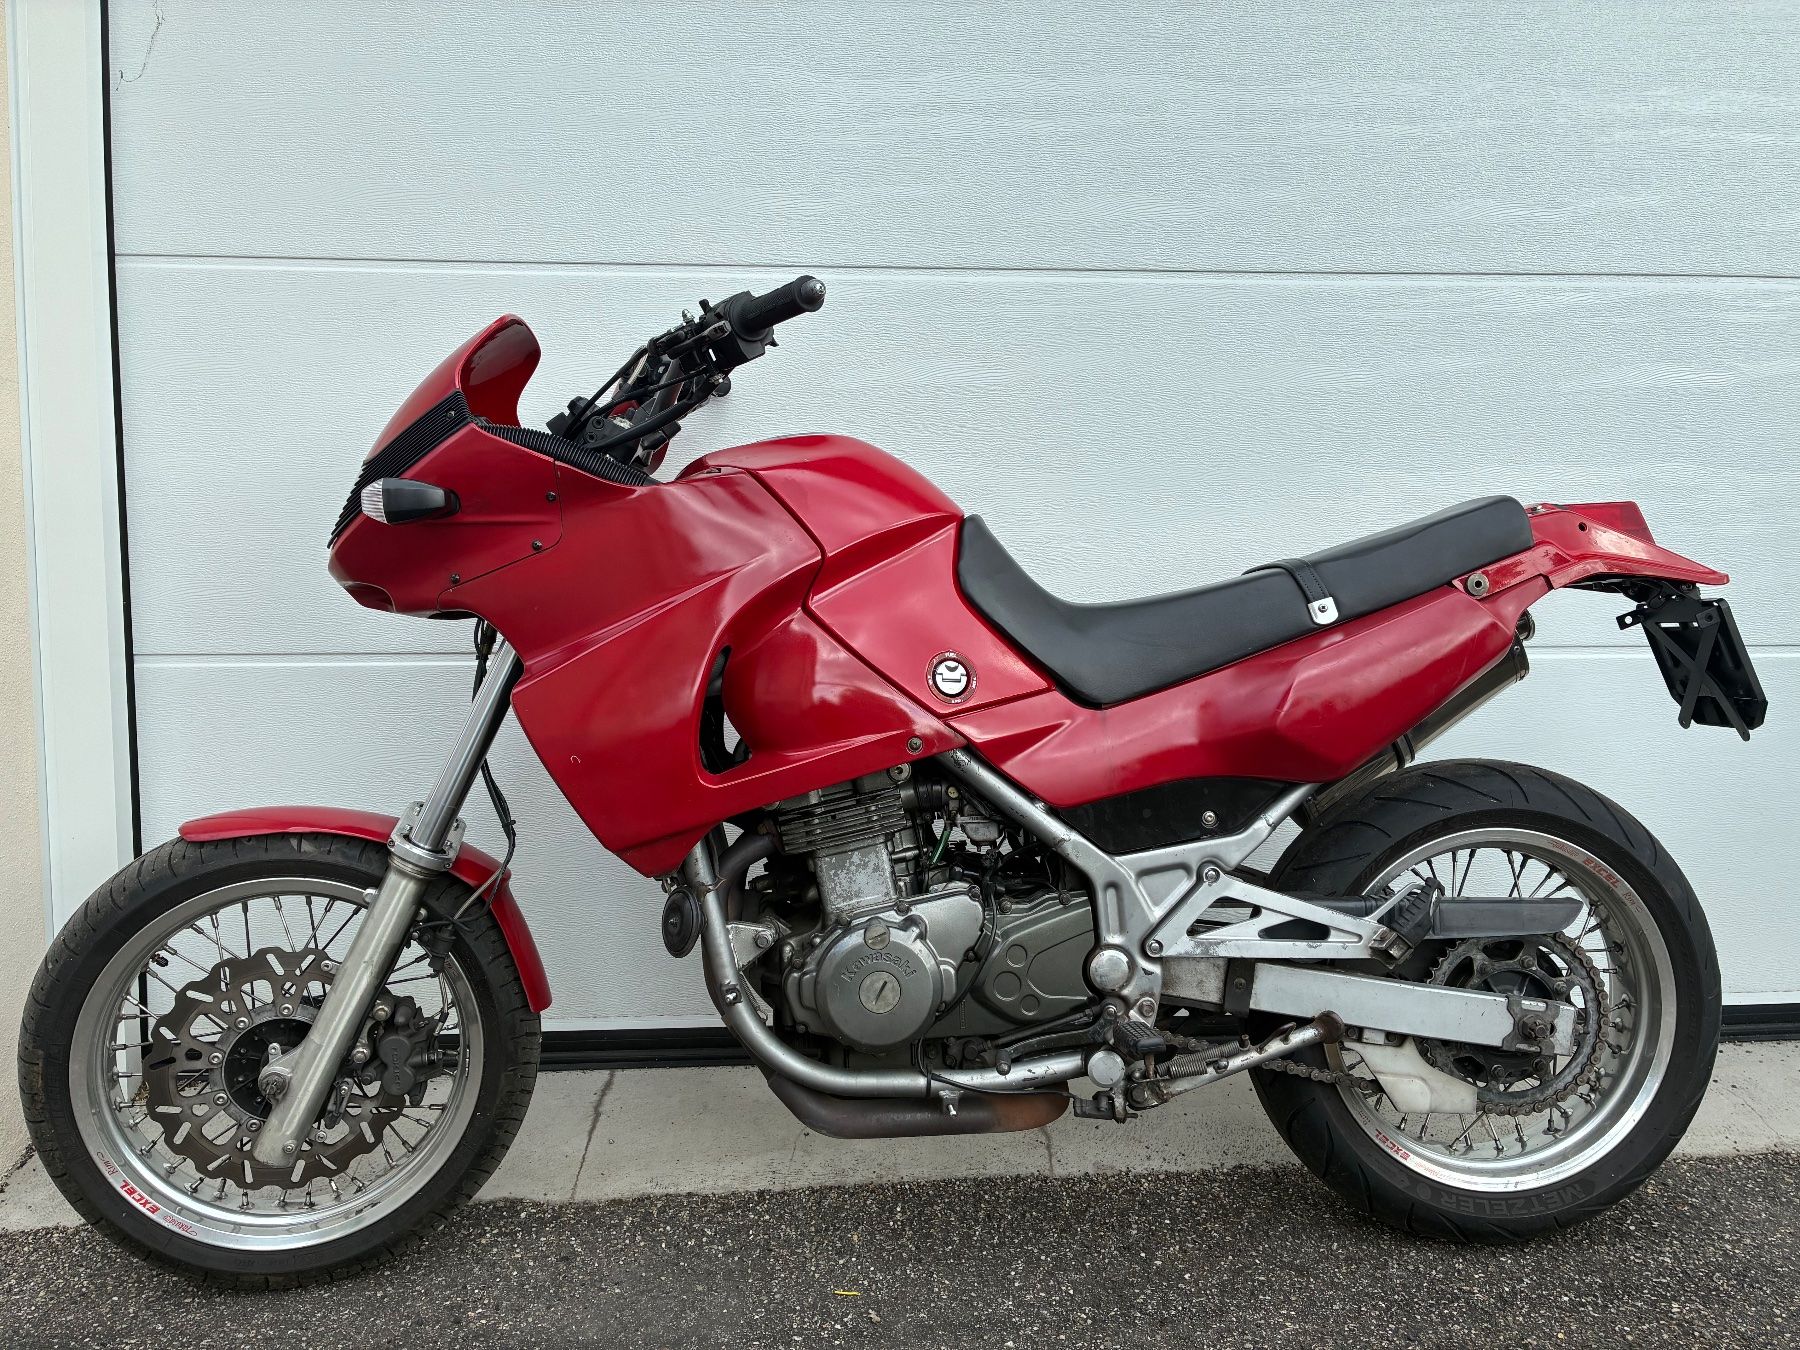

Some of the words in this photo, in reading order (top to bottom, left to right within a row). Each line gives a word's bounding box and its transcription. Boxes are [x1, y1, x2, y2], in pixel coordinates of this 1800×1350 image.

[1583, 857, 1620, 888] EXCEL
[841, 952, 917, 982] Kawasaki
[1375, 1128, 1410, 1160] EXCEL
[120, 1180, 160, 1215] EXCEL
[1440, 1183, 1588, 1216] METZELER
